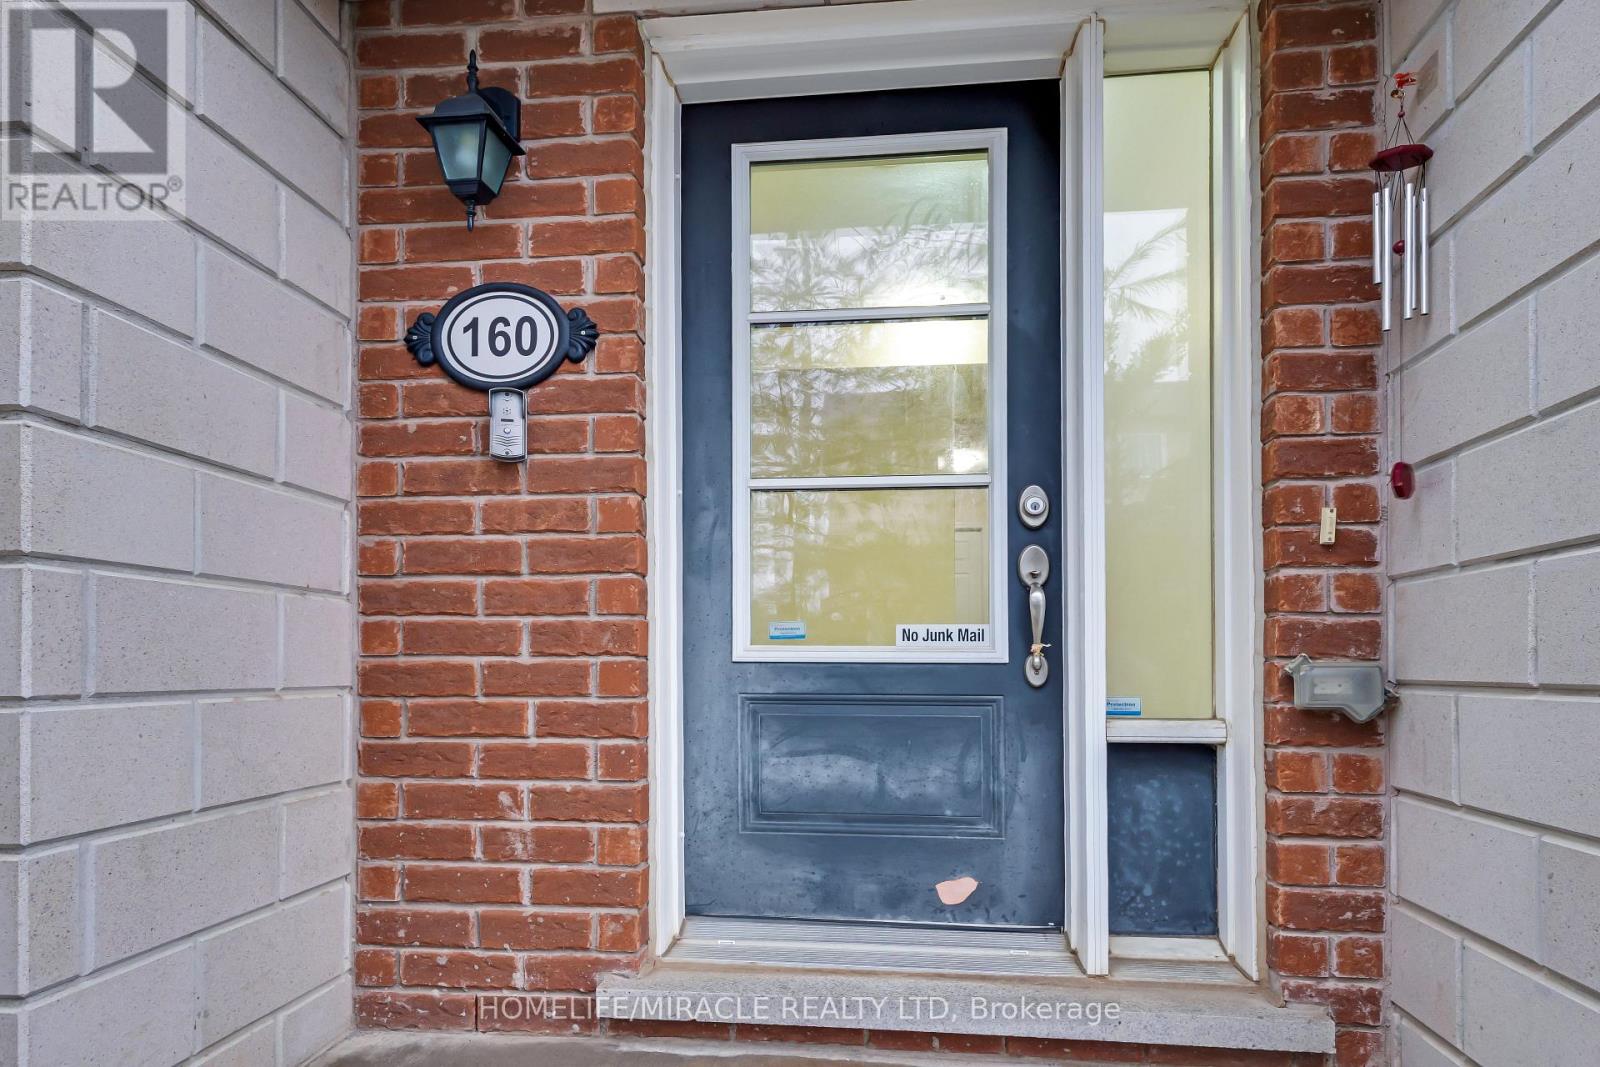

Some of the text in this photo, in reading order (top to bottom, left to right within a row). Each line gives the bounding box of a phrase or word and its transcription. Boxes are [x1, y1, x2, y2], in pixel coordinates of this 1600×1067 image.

[463, 316, 538, 357] 160
[902, 628, 985, 642] No Junk Mail
